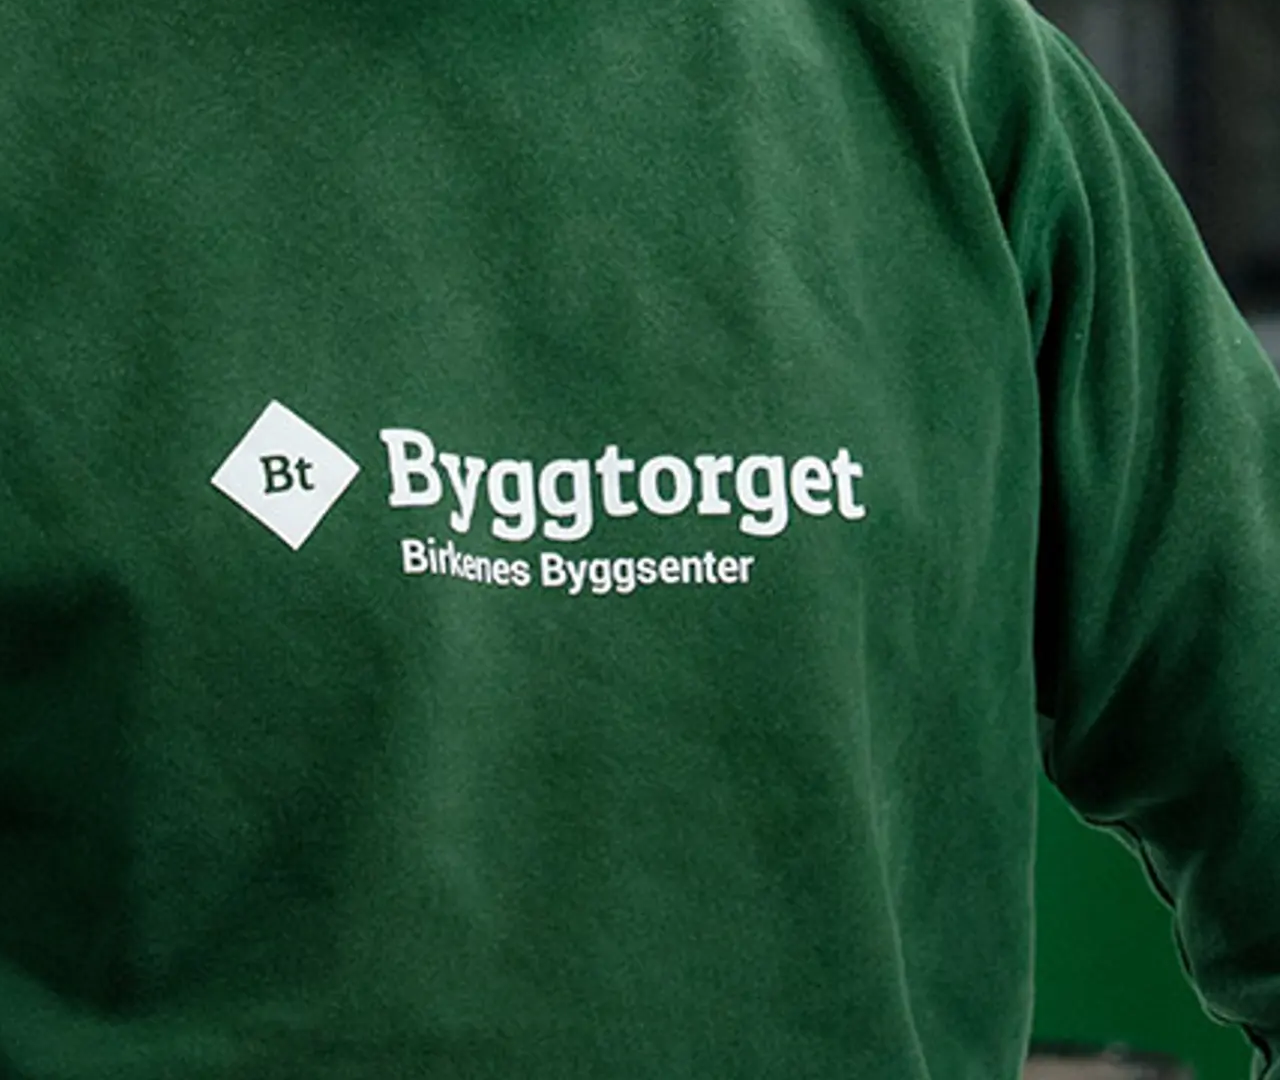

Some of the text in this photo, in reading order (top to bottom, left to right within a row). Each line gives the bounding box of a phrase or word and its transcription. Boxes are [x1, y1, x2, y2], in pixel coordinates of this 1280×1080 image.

[258, 454, 315, 495] Bt
[380, 428, 866, 542] Byggtorget
[401, 538, 755, 595] Birkenes Byggsenter
